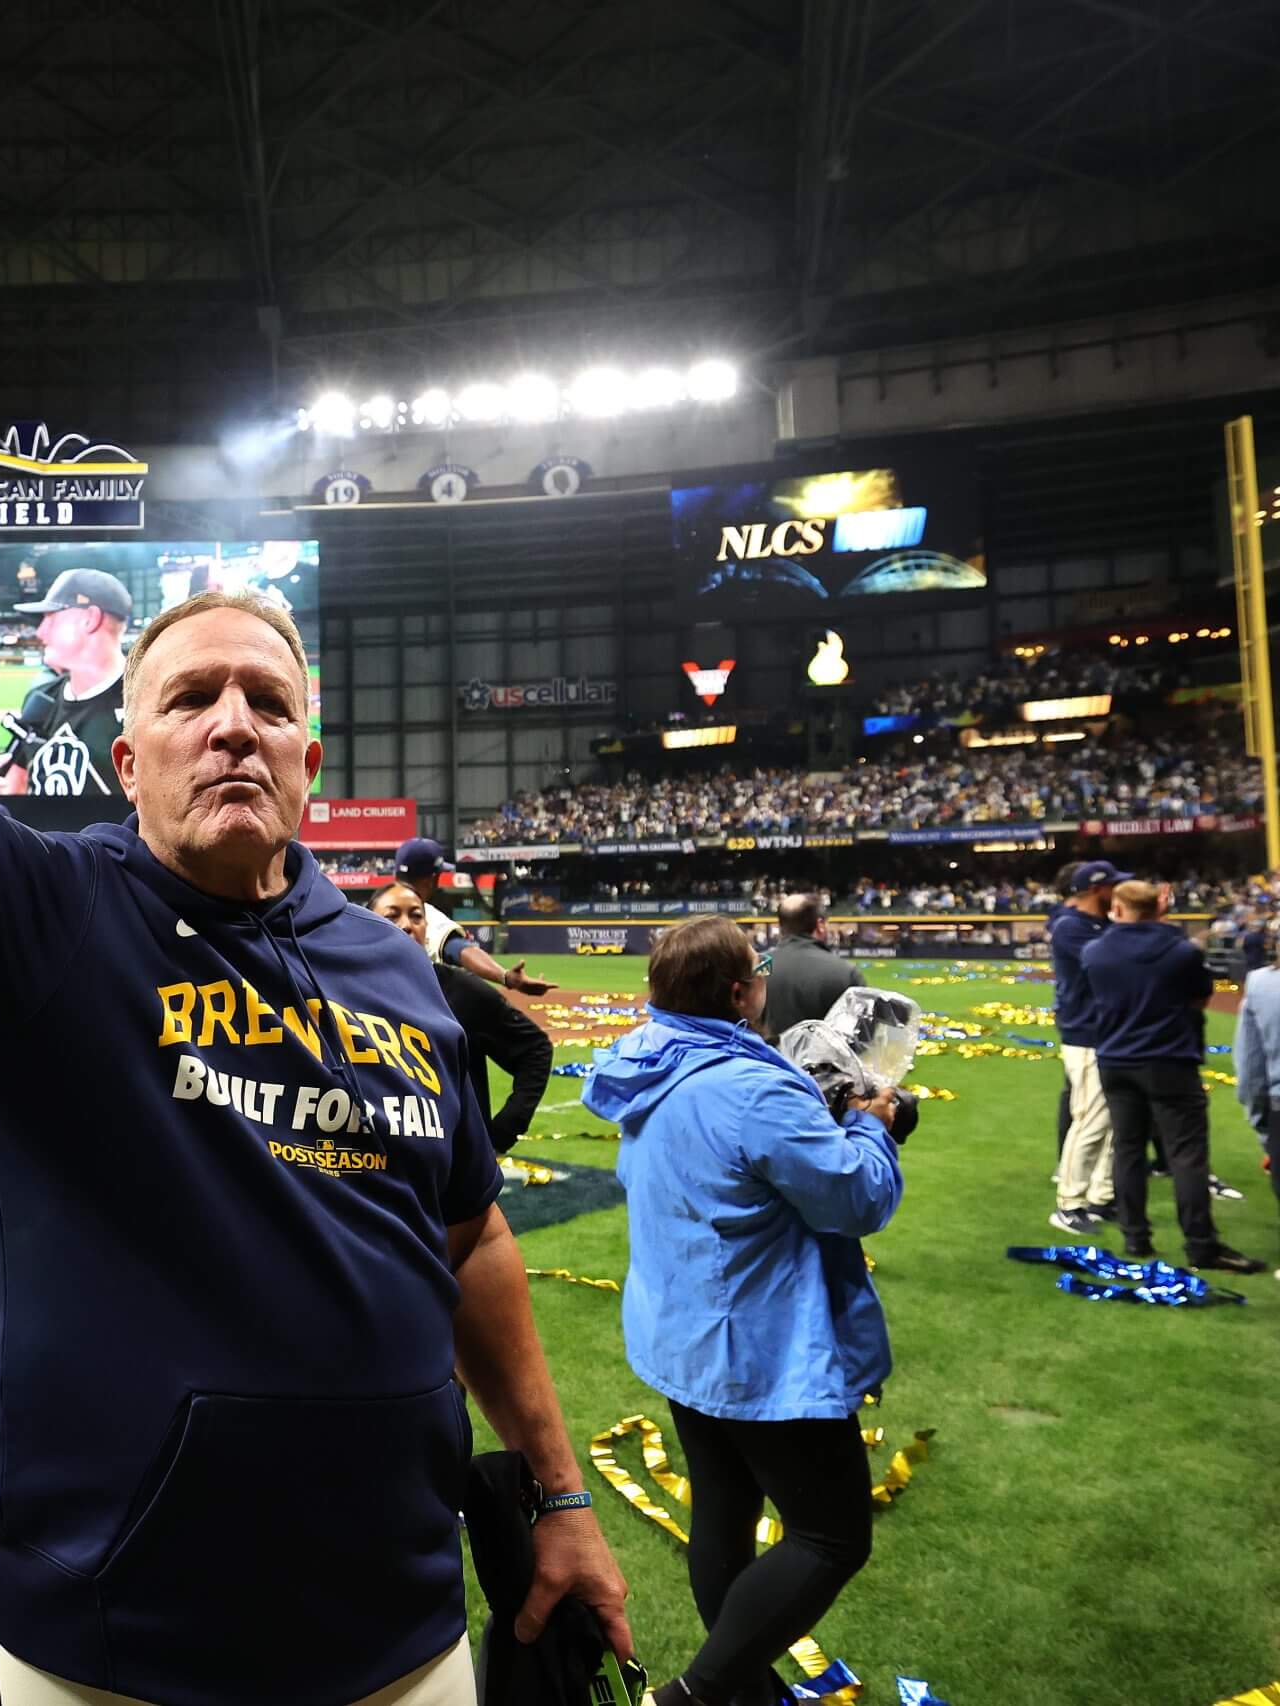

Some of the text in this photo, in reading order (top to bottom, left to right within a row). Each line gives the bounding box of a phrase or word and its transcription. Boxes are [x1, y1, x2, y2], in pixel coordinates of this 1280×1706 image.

[52, 479, 144, 501] FAMILY
[332, 487, 354, 503] 19
[716, 519, 826, 561] NLCS
[332, 806, 405, 818] LAND CRUISER
[727, 836, 755, 850] 620
[756, 835, 802, 848] WTMJ
[567, 927, 628, 939] WINTRUST
[156, 979, 441, 1096] BREWERS
[172, 1054, 445, 1139] BUILT FOR FALL
[268, 1140, 387, 1171] POSTSEASON
